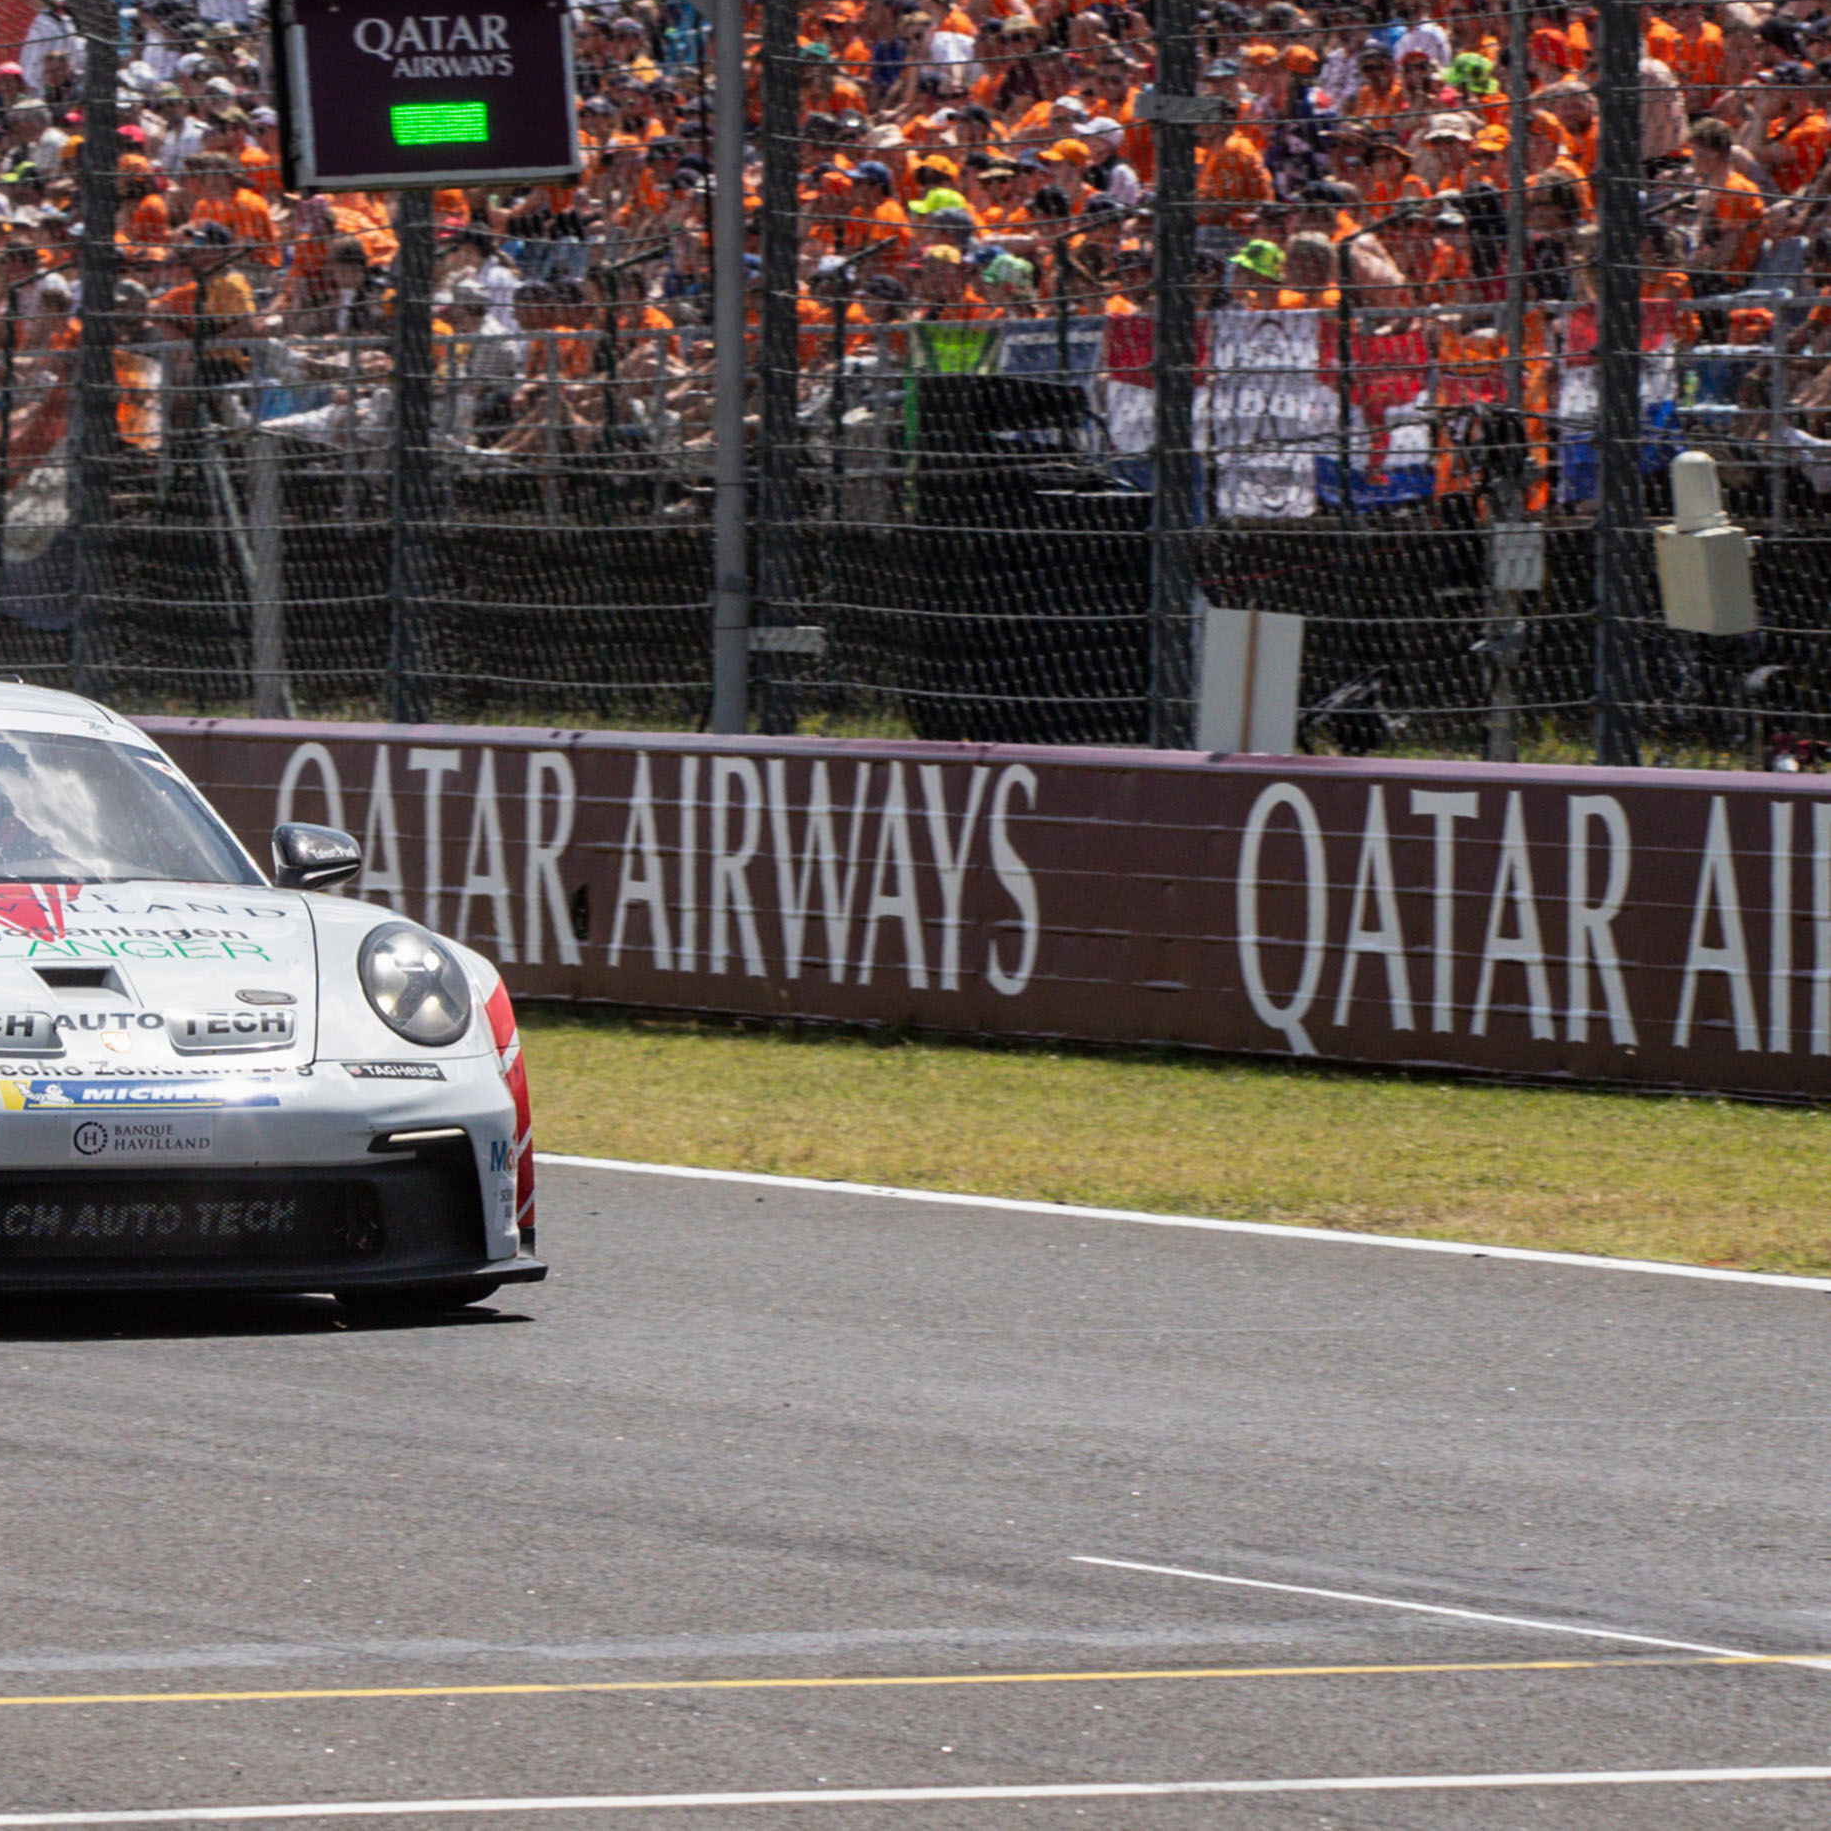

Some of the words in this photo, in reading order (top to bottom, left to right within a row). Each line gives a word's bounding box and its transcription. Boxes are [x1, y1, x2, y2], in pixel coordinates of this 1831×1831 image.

[353, 14, 511, 61] QATAR
[392, 54, 515, 79] AIRWAYS
[608, 749, 1040, 997] AIRWAYS
[1237, 782, 1639, 1056] QATAR
[55, 1012, 165, 1031] AUTO
[183, 1011, 287, 1036] TECH
[114, 1124, 174, 1137] BANQUE
[114, 1136, 211, 1152] HAVILLAND
[71, 1203, 184, 1238] AUTO
[196, 1198, 299, 1236] TECH
